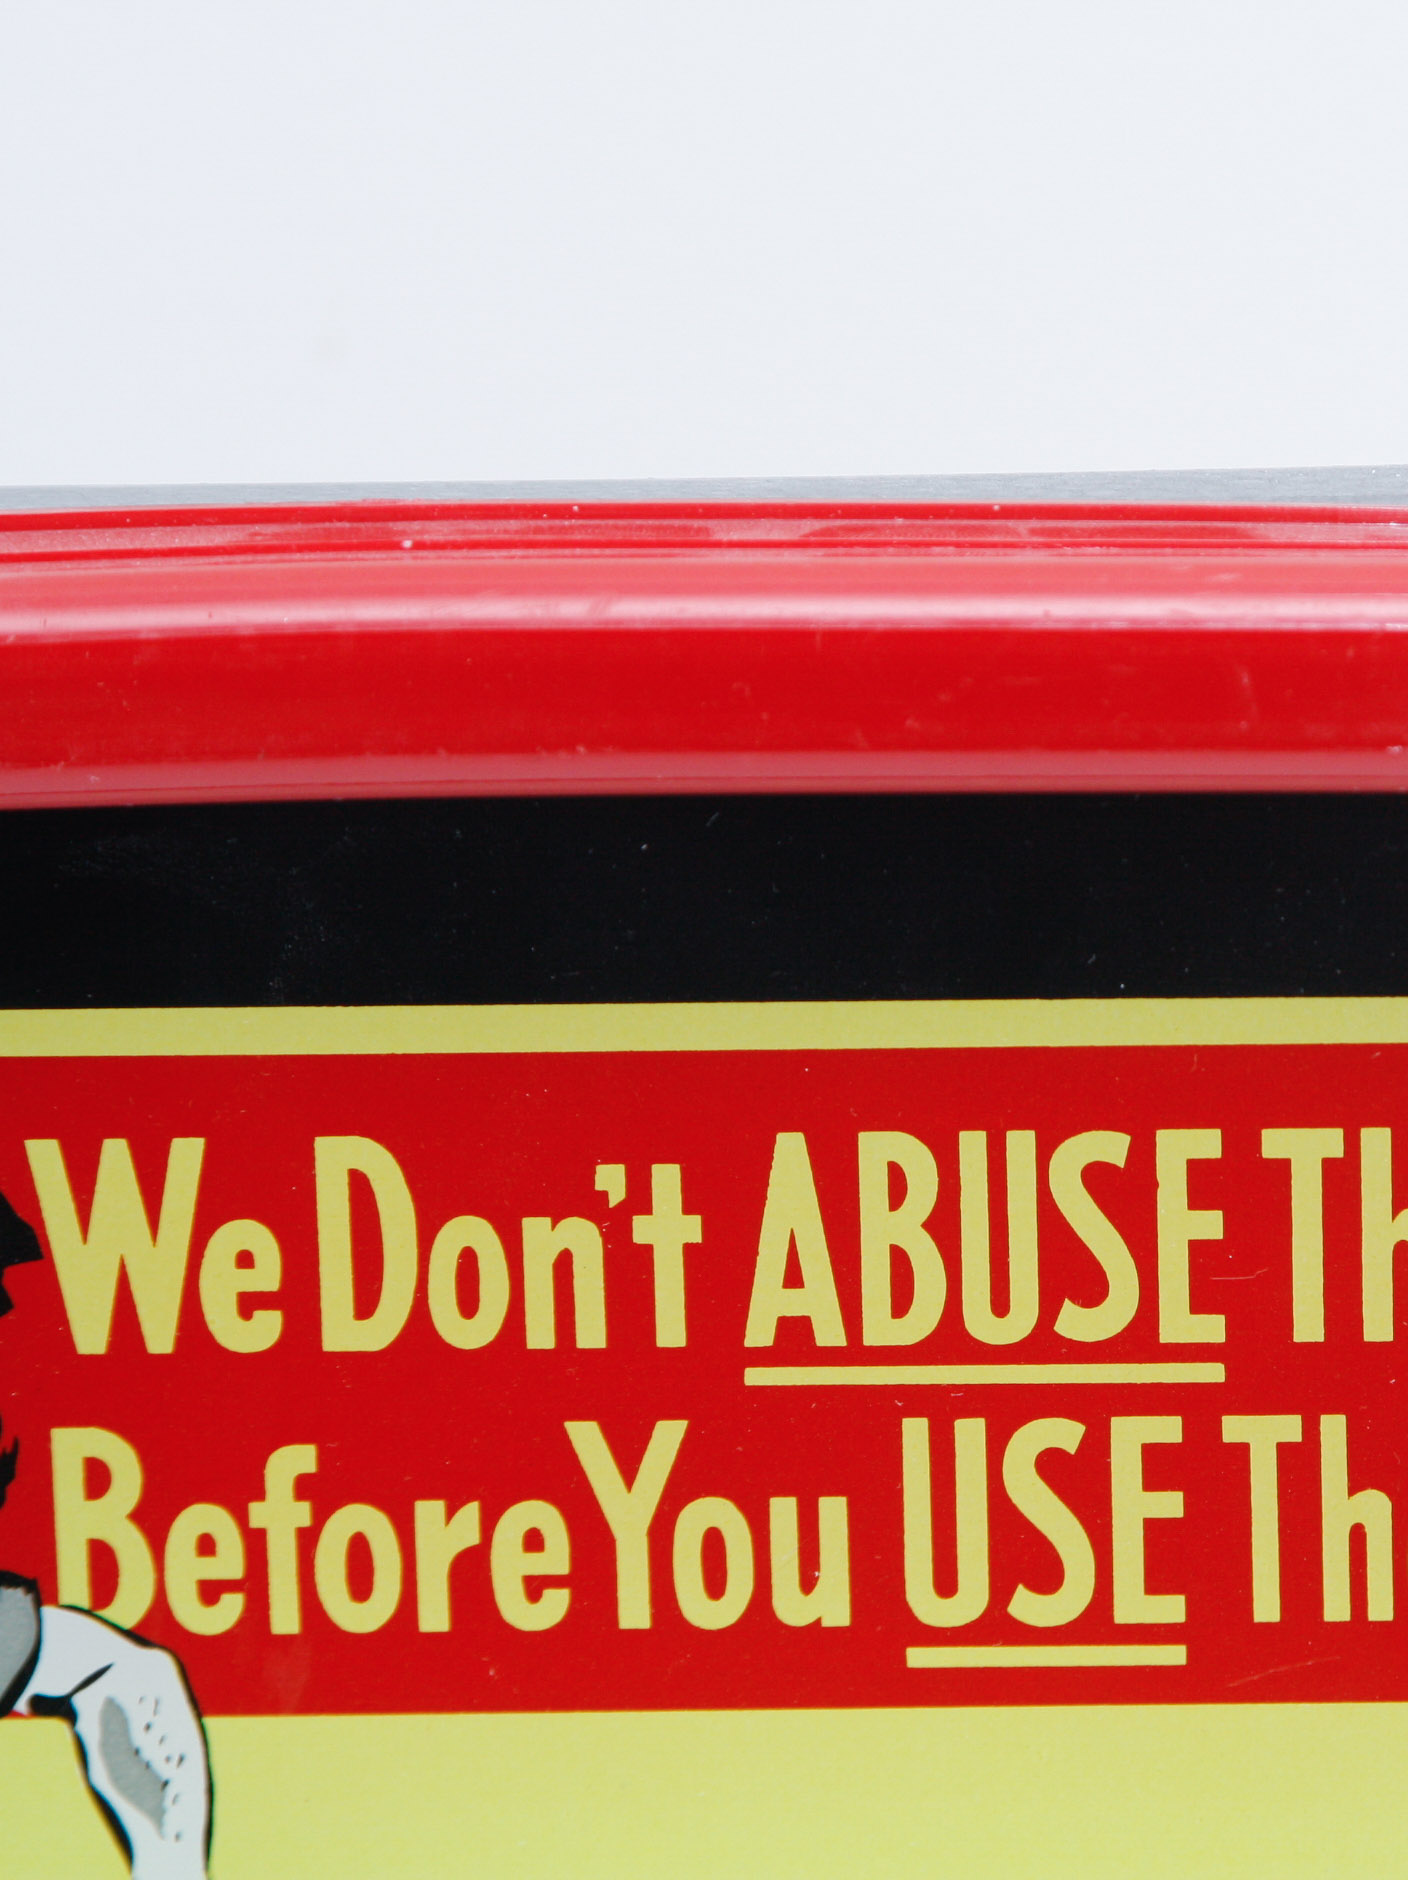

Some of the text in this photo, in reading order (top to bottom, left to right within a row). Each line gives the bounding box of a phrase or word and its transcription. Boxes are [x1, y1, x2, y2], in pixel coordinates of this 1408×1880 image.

[24, 1137, 283, 1354] We
[314, 1136, 702, 1352] Don't
[744, 1129, 1225, 1347] ABUSE
[51, 1427, 571, 1635] Before
[564, 1420, 851, 1631] You
[902, 1415, 1187, 1627] USE
